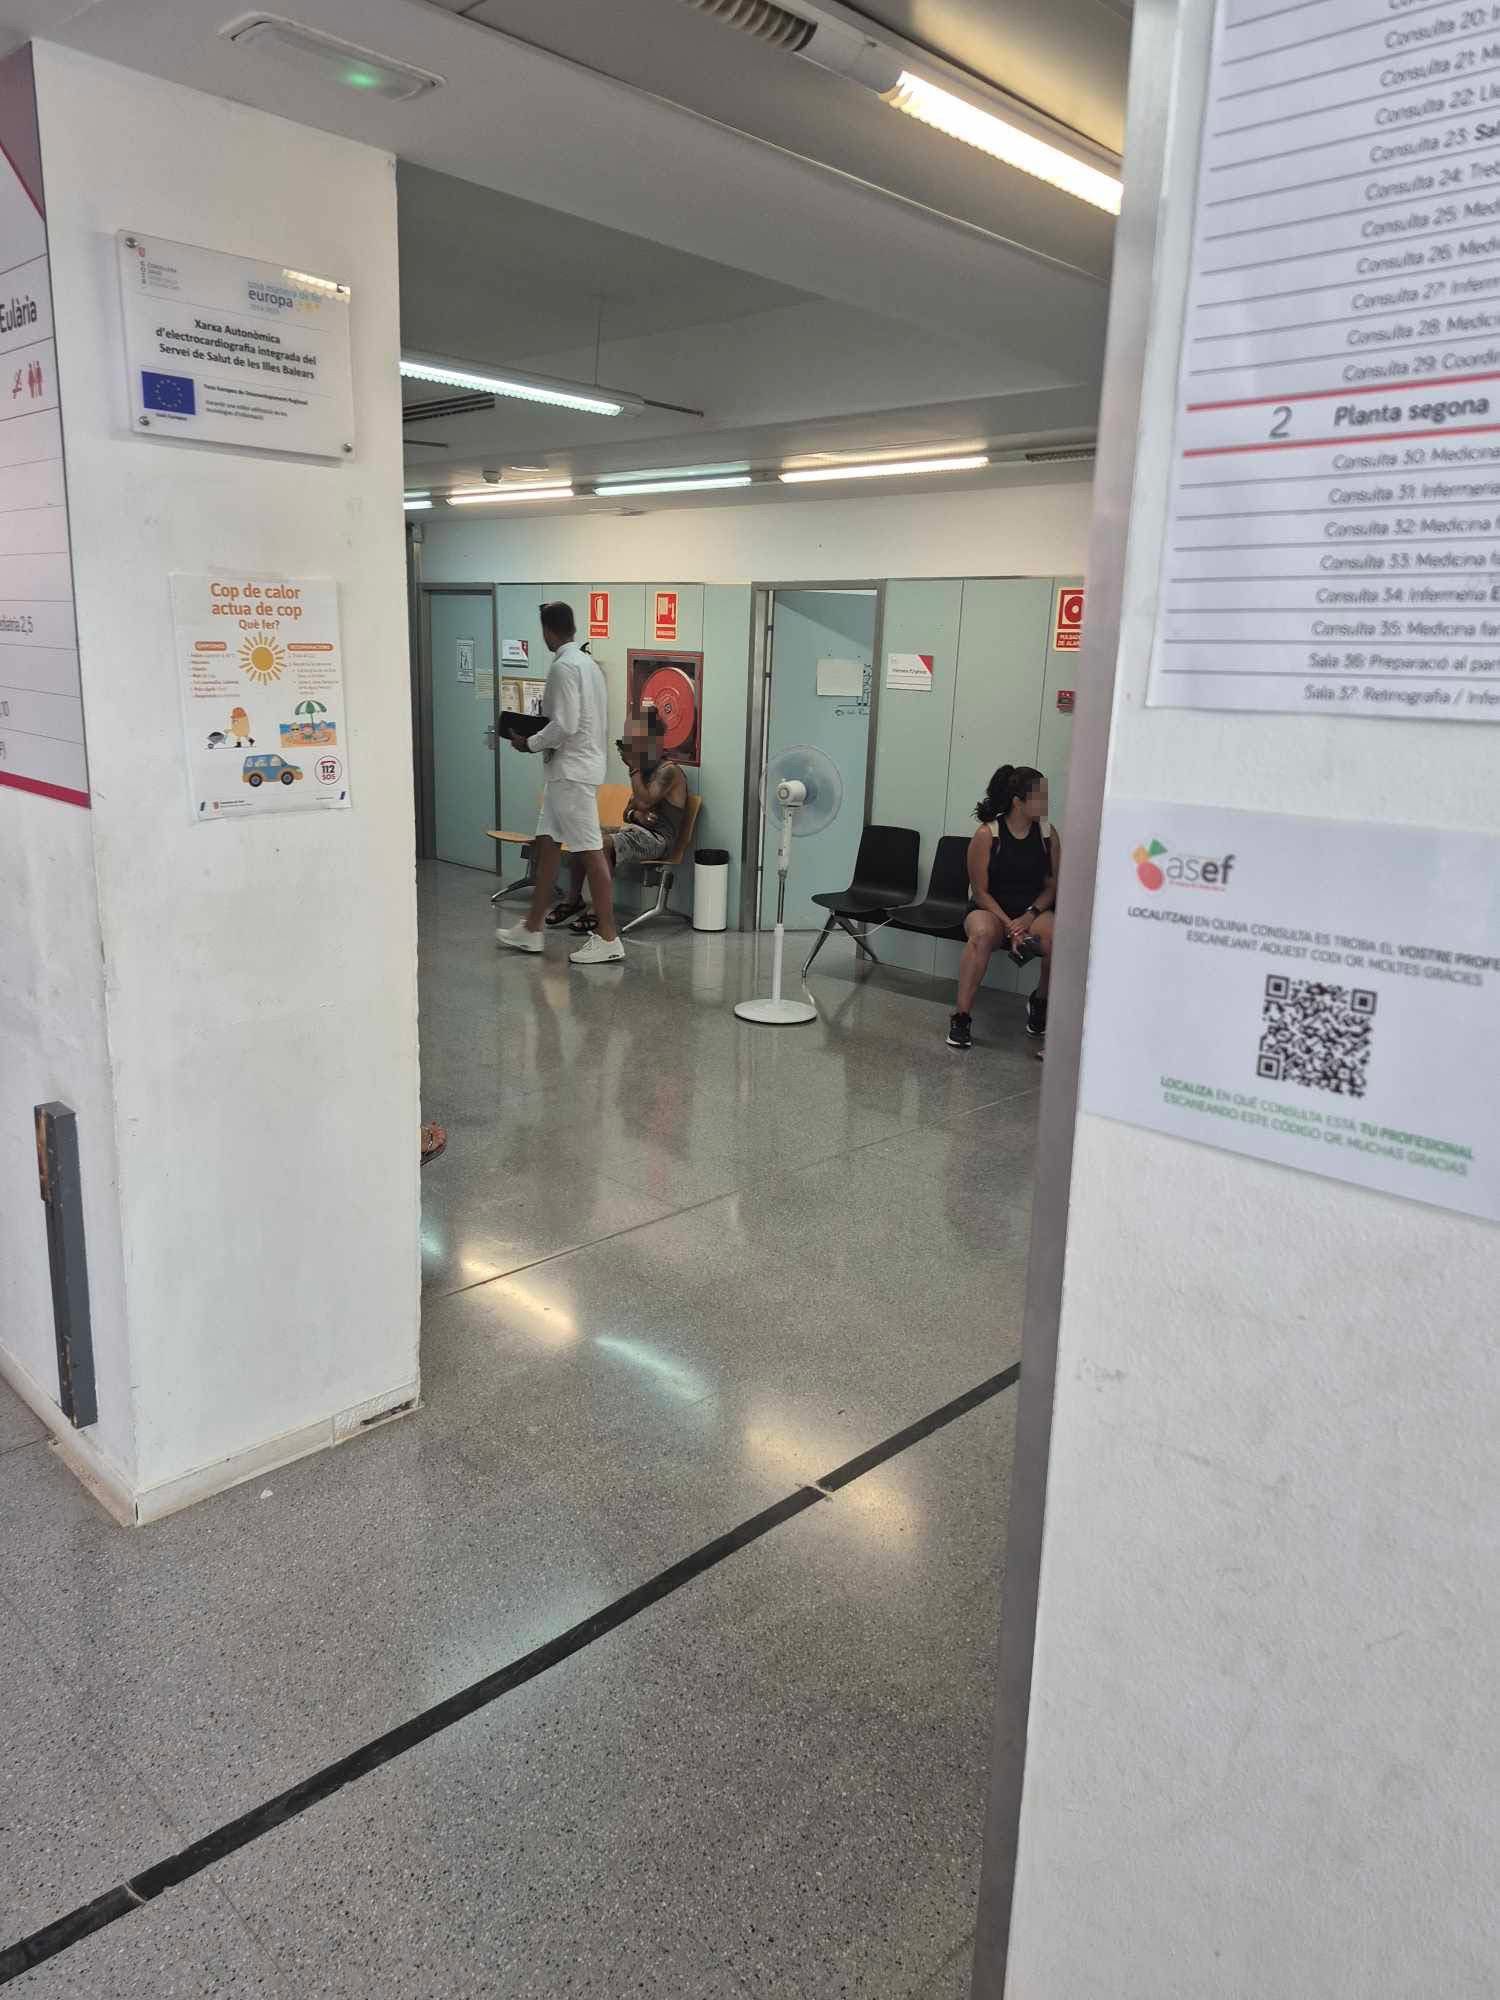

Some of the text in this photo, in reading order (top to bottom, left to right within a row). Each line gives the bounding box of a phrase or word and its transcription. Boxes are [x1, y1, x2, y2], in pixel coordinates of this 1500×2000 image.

[1384, 17, 1455, 48] Consulta
[1380, 60, 1450, 87] Consulta
[1375, 98, 1445, 125] Consulta
[1369, 138, 1439, 162] Consulta
[1364, 175, 1434, 201] Consulta
[1361, 213, 1430, 237] Consulta
[1356, 251, 1424, 274] Consulta
[248, 289, 293, 308] europa
[1351, 288, 1419, 309] Consulta
[194, 319, 281, 344] Xarxa Autonòmica
[1346, 323, 1414, 345] Consulta
[156, 327, 317, 366] d'electrocardiografia integrada del
[159, 343, 314, 379] Servei de Salut de les Illes Balears
[1342, 360, 1410, 382] Consulta
[1269, 398, 1490, 439] 2 Planta segona
[1332, 453, 1398, 471] Consulta
[1328, 487, 1394, 504] Consulta
[1324, 521, 1389, 537] Consulta
[1420, 517, 1492, 533] Medicina
[1320, 554, 1385, 570] Consulta
[1415, 551, 1487, 568] Medicina
[210, 582, 301, 601] Cop de calor
[1315, 587, 1379, 604] Consulta
[211, 601, 303, 620] actua de cop
[1311, 619, 1376, 636] Consulta
[1407, 620, 1477, 636] Medicina
[1309, 652, 1339, 669] Sala
[1368, 653, 1450, 671] Preparació
[1454, 654, 1468, 671] al
[1304, 684, 1335, 701] Sala
[321, 765, 336, 774] 112
[321, 773, 336, 781] SOS
[1166, 854, 1236, 885] asef
[1128, 906, 1194, 926] LOCALITZAU
[1194, 915, 1210, 928] EN
[1211, 918, 1248, 933] QUINA
[1251, 923, 1312, 943] CONSULTA
[1314, 932, 1330, 946] ES
[1334, 934, 1377, 951] TROBA
[1398, 944, 1452, 964] VOSTRE
[1186, 929, 1258, 951] ESCANEJANT
[1260, 940, 1307, 959] AQUEST
[1311, 949, 1342, 964] CODI
[1368, 957, 1421, 977] MOLTES
[1160, 1075, 1213, 1098] LOCALIZA
[1216, 1088, 1231, 1102] EN
[1260, 1099, 1322, 1123] CONSULTA
[1360, 1121, 1378, 1137] TU
[1379, 1126, 1473, 1160] PROFESIONAL
[1163, 1090, 1239, 1120] ESCANEANDO
[1241, 1110, 1269, 1129] ESTE
[1346, 1136, 1404, 1161] MUCHAS
[1407, 1150, 1467, 1177] GRACIAS
